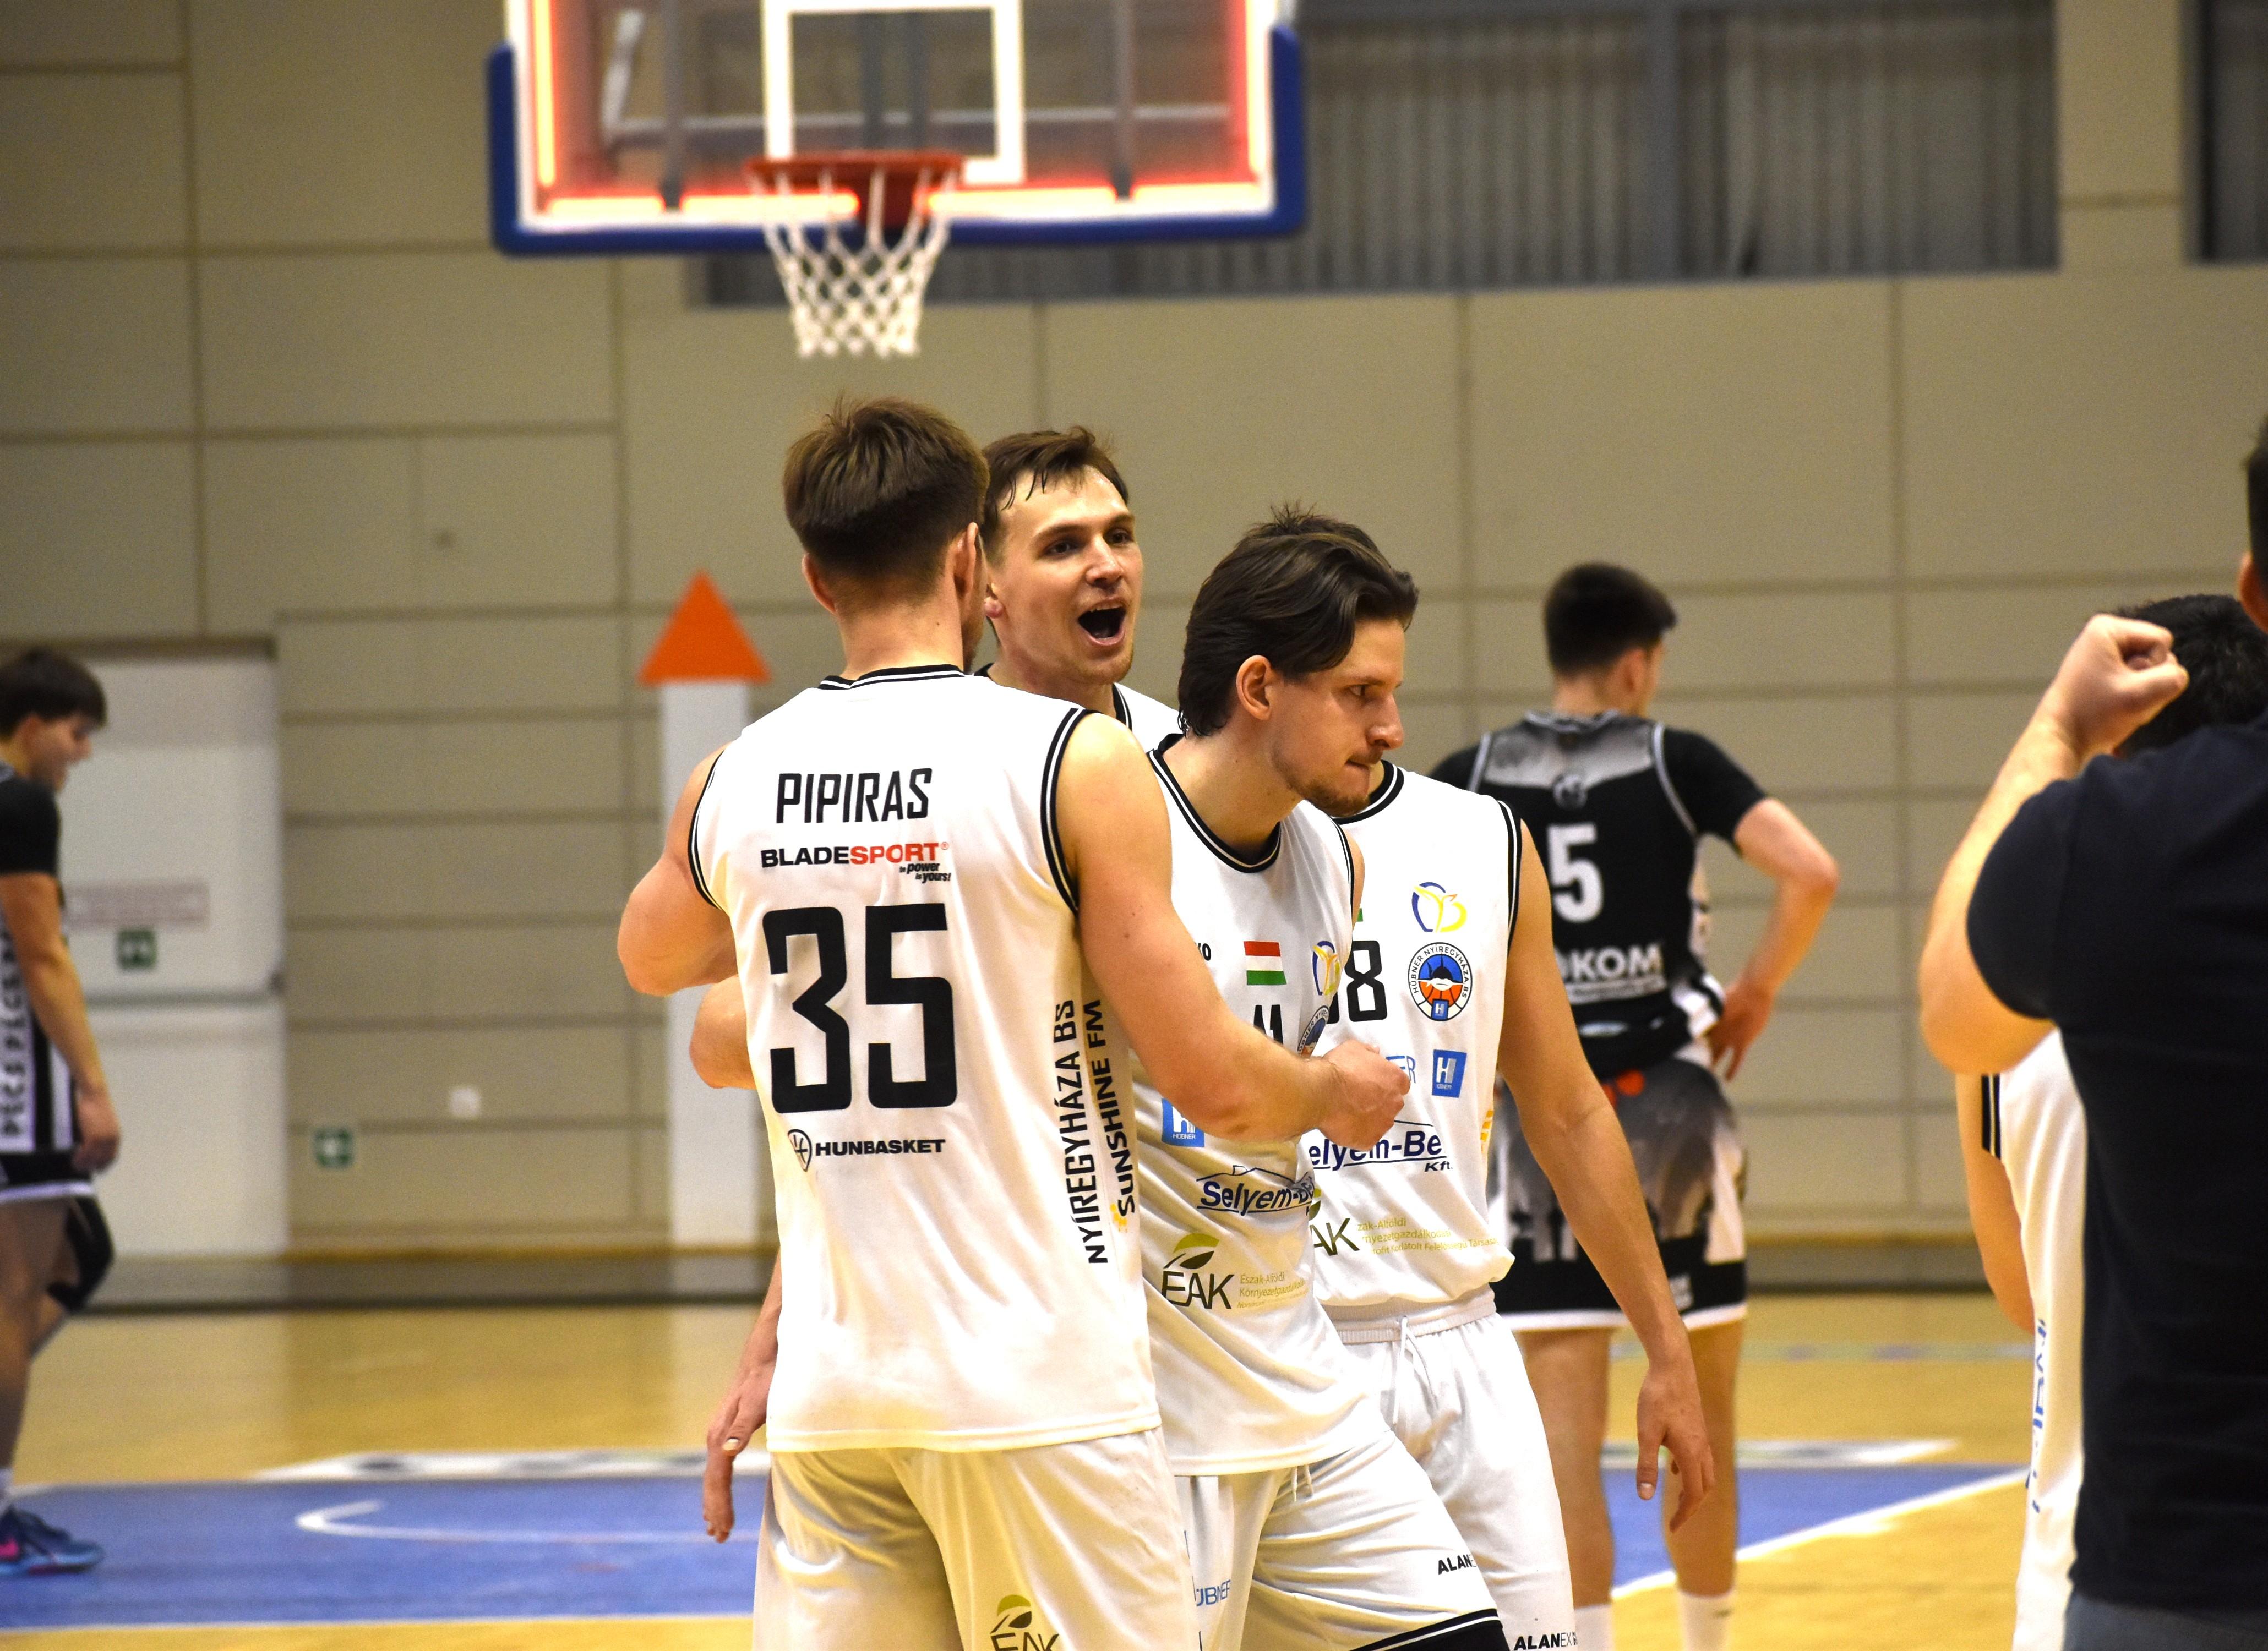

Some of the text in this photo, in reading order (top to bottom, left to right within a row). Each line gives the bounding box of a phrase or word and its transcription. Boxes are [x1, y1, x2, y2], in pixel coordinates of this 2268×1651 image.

[776, 768, 933, 824] PIPIRAS
[906, 862, 940, 874] power
[922, 873, 952, 884] yours!
[1546, 823, 1604, 924] 5
[1327, 940, 1388, 1024] 8
[1409, 944, 1469, 998] HÜBNER NYÍREGYHÁZA BS
[762, 903, 958, 1114] 35
[1053, 999, 1109, 1264] NYÍREGYHÁZA BS
[1083, 999, 1135, 1217] SUNSHINE FM
[815, 1139, 946, 1156] HUNBASKET
[1424, 1160, 1453, 1173] Kft.
